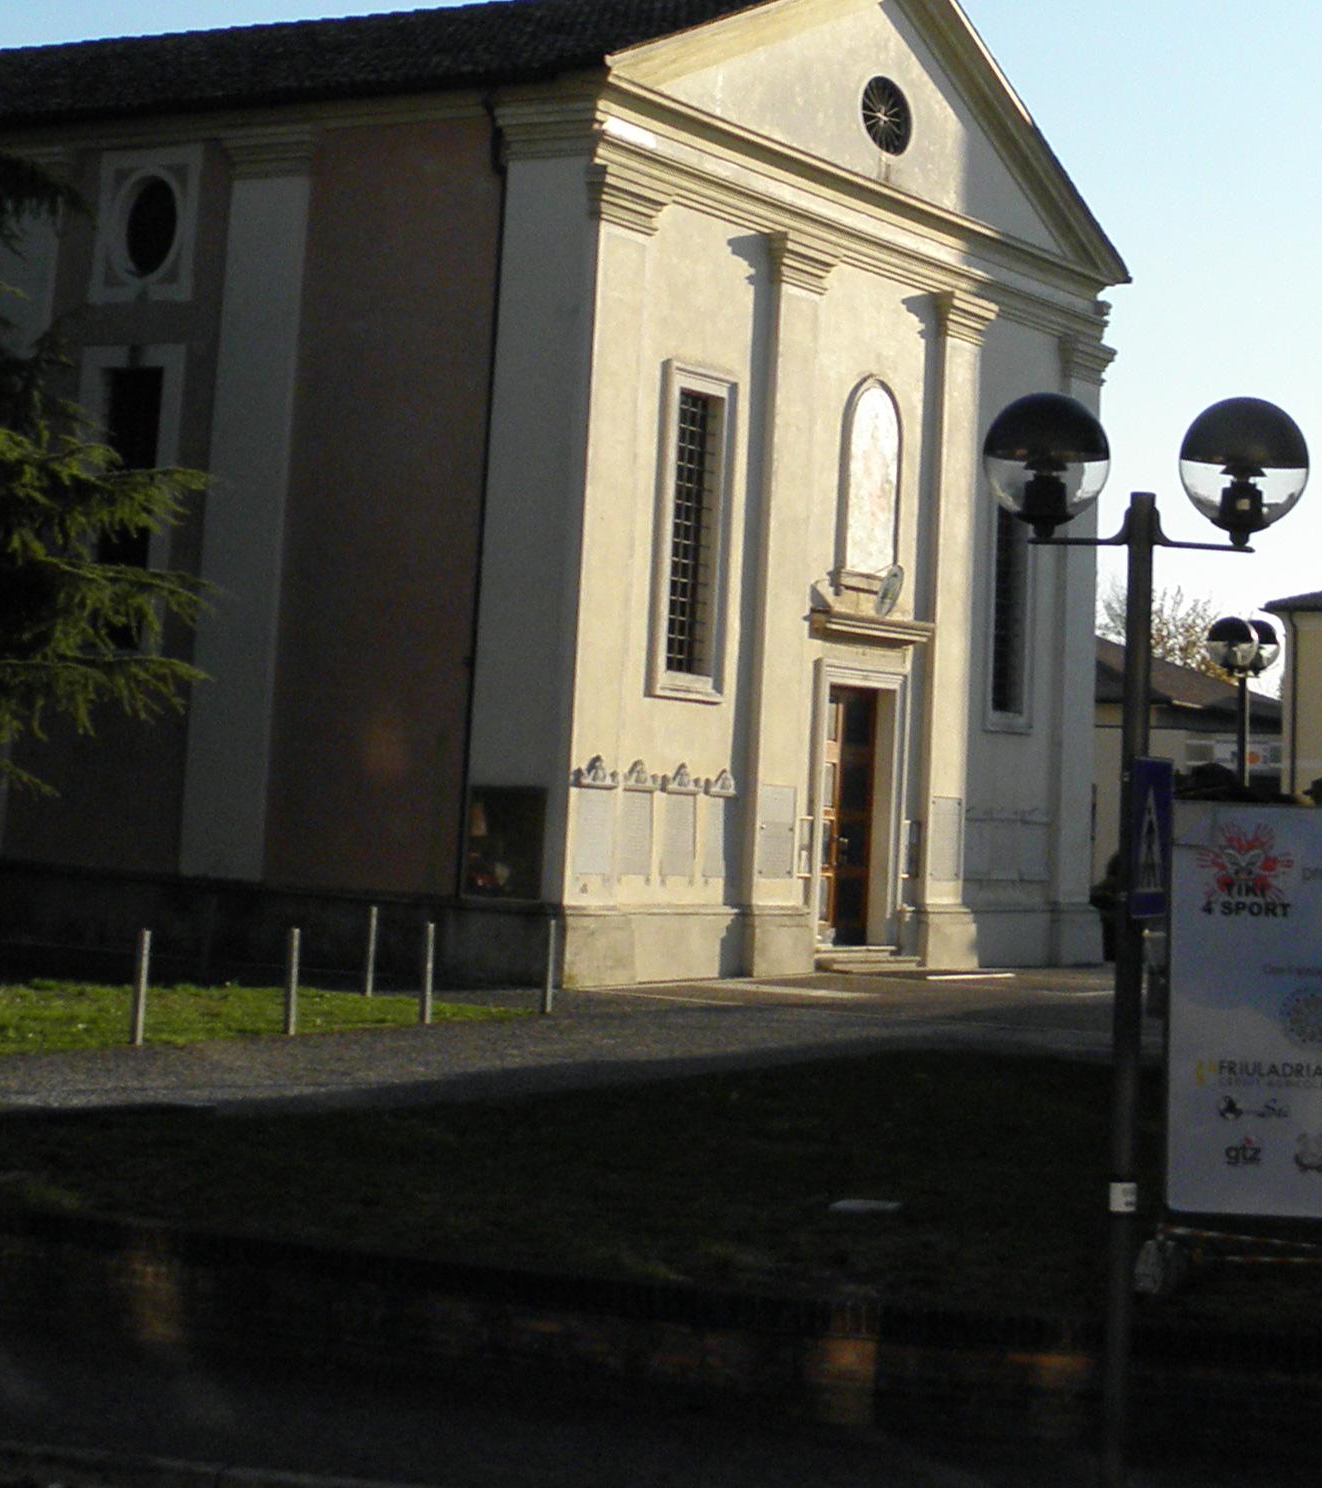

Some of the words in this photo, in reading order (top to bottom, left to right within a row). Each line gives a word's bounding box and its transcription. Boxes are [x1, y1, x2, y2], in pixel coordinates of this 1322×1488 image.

[1201, 900, 1214, 915] 4
[1220, 900, 1291, 918] SPORT
[1225, 1142, 1262, 1166] gtz
